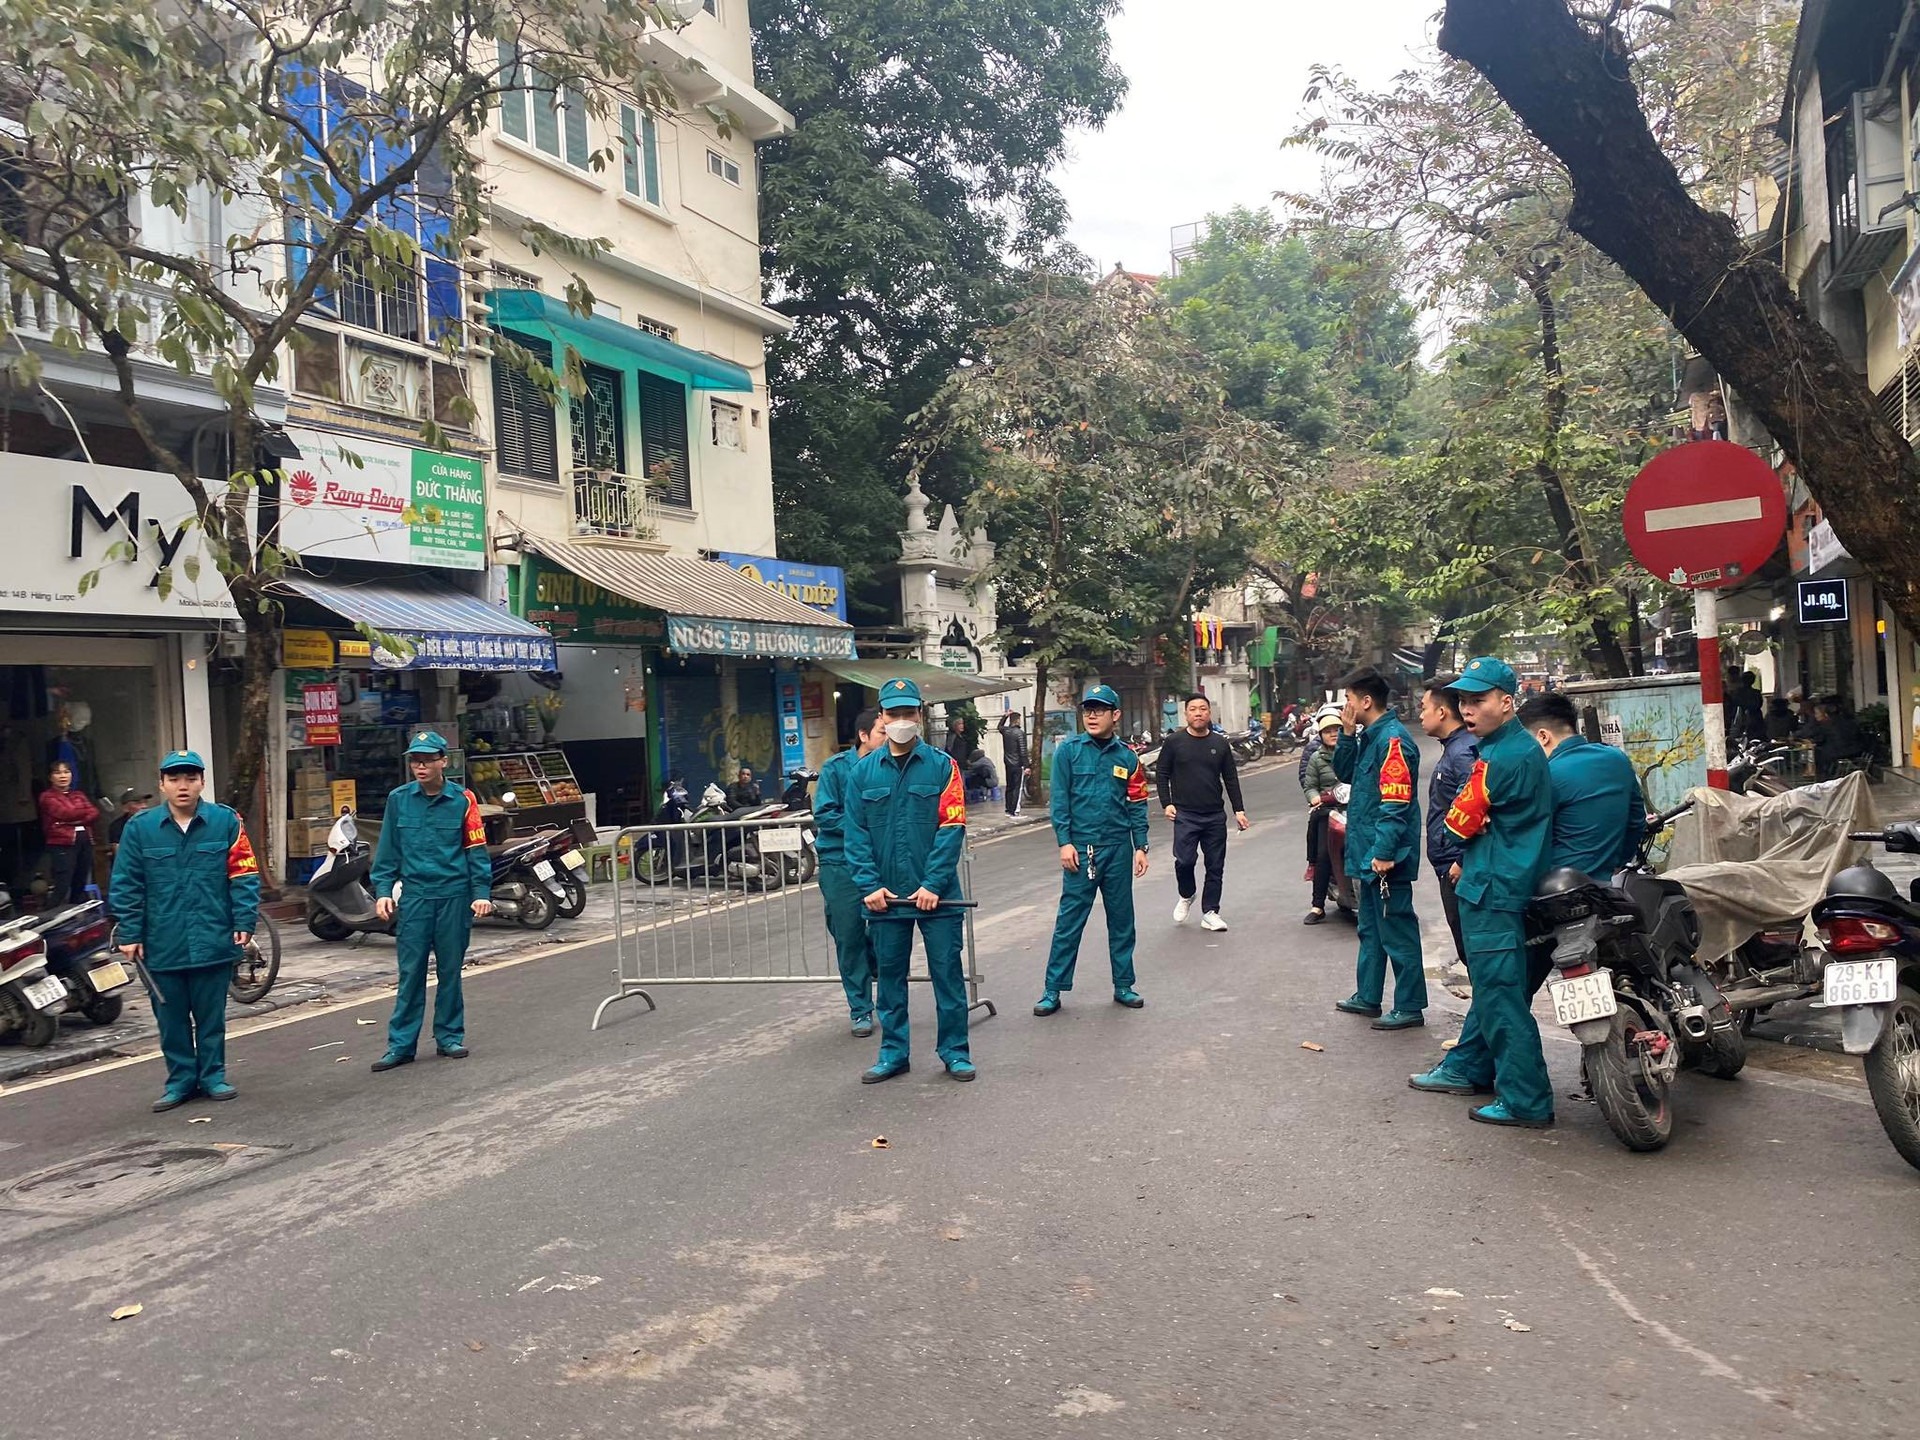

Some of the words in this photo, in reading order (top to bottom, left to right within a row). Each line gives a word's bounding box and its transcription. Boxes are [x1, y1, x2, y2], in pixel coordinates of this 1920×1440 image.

[432, 462, 448, 476] CỬA
[450, 467, 472, 480] HÀNG
[416, 478, 442, 498] ĐỨC
[444, 481, 482, 504] THẮNG
[71, 485, 188, 587] My
[536, 572, 574, 603] SINH
[673, 624, 725, 650] NƯỚC
[730, 626, 750, 650] ÉP
[754, 630, 810, 654] HƯƠNG
[813, 636, 852, 655] JUICE
[1600, 720, 1620, 734] NHÀ
[1836, 963, 1884, 983] 29-K1
[1560, 978, 1601, 1002] 29-C1
[1830, 981, 1890, 1002] 866.61
[1558, 995, 1612, 1022] 687.56
